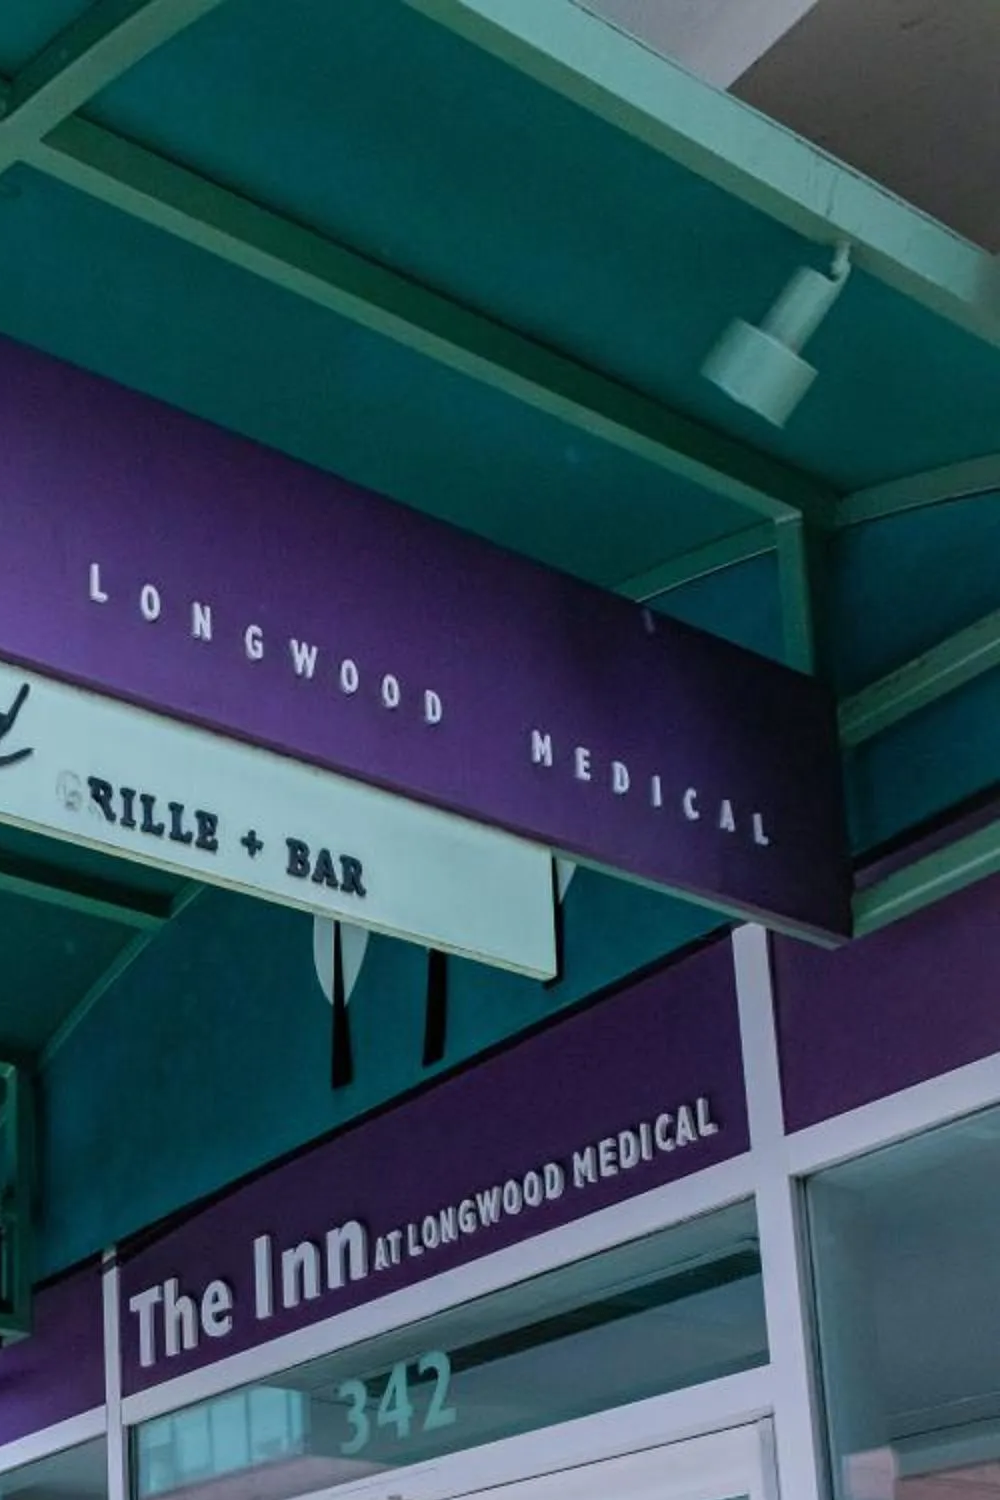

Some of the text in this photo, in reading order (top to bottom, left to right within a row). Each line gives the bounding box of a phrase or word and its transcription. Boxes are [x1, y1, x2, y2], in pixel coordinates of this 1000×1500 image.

[89, 562, 443, 726] LONGWOOD
[531, 729, 770, 847] MEDICAL
[285, 837, 367, 898] BAR
[129, 1097, 719, 1368] The Inn AT LONGWOOD MEDICAL
[338, 1350, 458, 1456] 342
